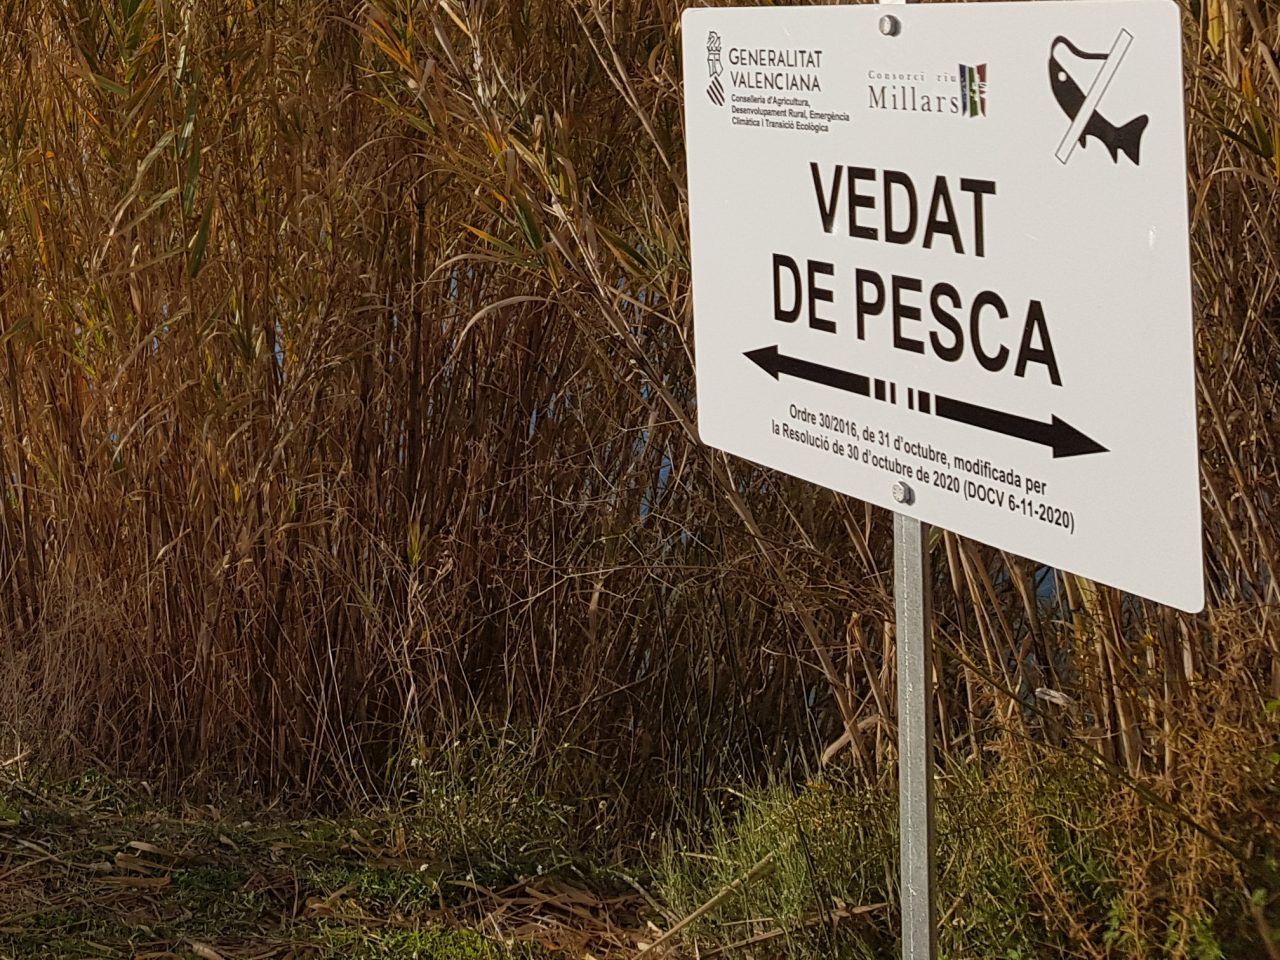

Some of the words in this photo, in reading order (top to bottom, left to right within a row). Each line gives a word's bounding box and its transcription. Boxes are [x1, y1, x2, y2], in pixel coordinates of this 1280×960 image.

[728, 48, 823, 68] GENERALITAT
[730, 71, 821, 92] VALENCIANA
[868, 70, 925, 81] Consorci
[937, 72, 957, 82] riu
[731, 94, 765, 105] Conselleria
[767, 96, 811, 108] d'Agricultura,
[868, 85, 959, 114] Millars
[731, 105, 787, 118] Desenvolupament
[788, 109, 808, 120] Rural,
[810, 111, 850, 122] Emergència
[765, 118, 795, 130] Transició
[809, 162, 997, 257] VEDAT
[772, 253, 837, 334] DE
[855, 268, 1063, 387] PESCA
[790, 404, 816, 425] Ordre
[819, 412, 860, 441] 30/2016,
[863, 426, 875, 443] de
[878, 430, 890, 447] 31
[954, 456, 1022, 488] modificada
[1025, 477, 1047, 495] per
[772, 419, 780, 435] la
[782, 423, 830, 451] Resolució
[833, 440, 845, 456] de
[847, 443, 859, 461] 30
[862, 449, 913, 478] d'octubre
[916, 465, 929, 484] de
[933, 470, 960, 493] 2020
[964, 479, 1004, 507] (DOCV
[1008, 494, 1075, 534] 6-11-2020)
